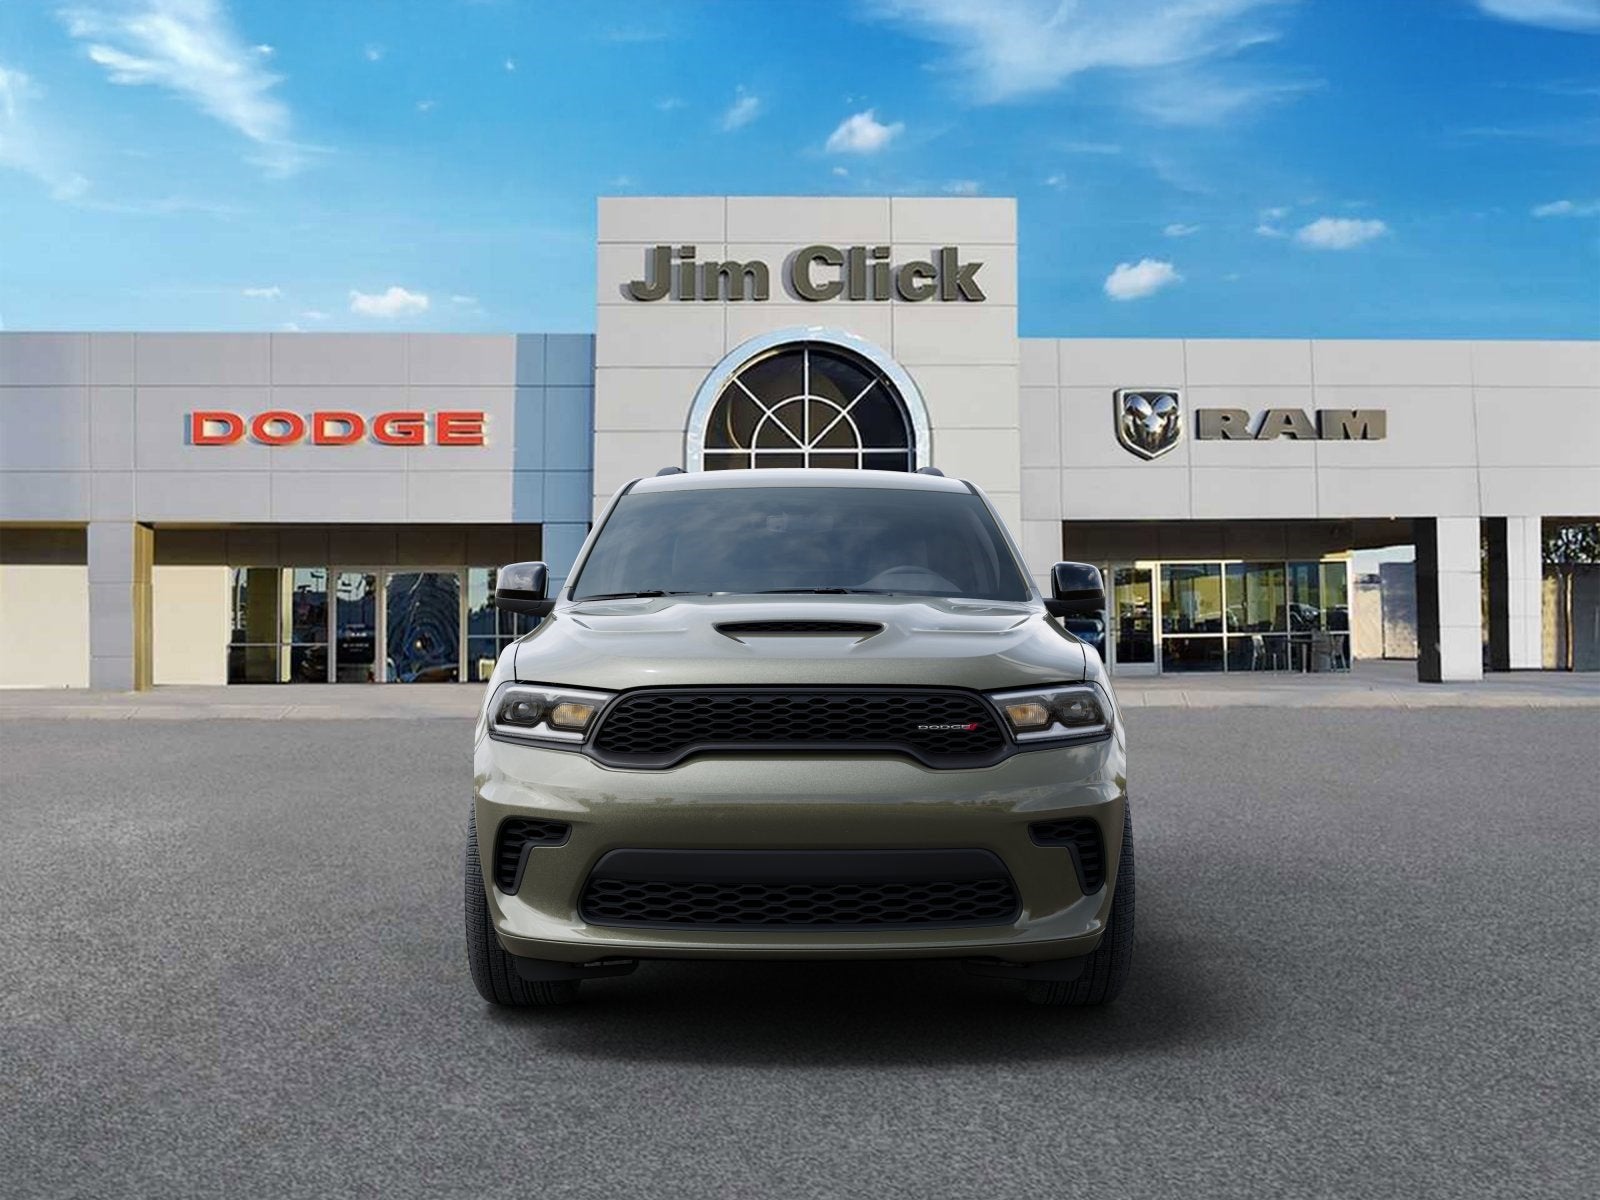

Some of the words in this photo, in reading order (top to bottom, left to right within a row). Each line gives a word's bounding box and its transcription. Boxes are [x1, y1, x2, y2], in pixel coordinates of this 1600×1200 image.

[626, 244, 769, 302] Jim
[790, 244, 986, 302] Click
[189, 410, 485, 446] DODGE
[1196, 409, 1387, 441] RAM
